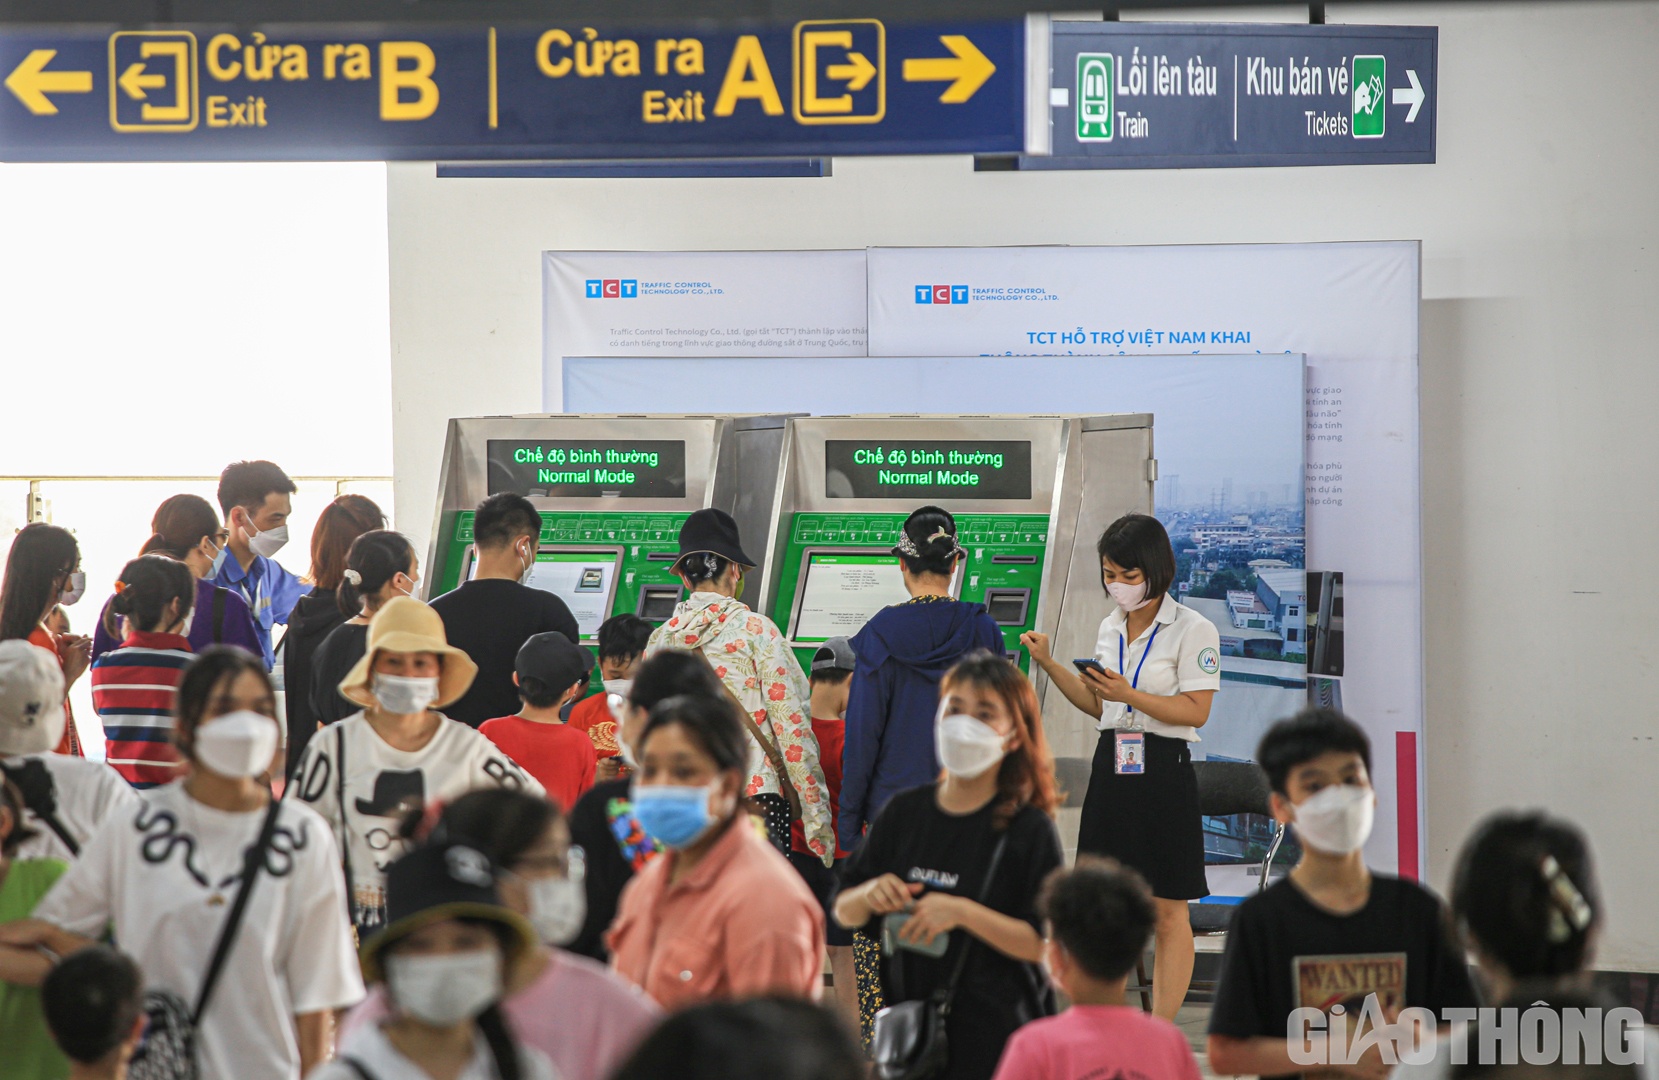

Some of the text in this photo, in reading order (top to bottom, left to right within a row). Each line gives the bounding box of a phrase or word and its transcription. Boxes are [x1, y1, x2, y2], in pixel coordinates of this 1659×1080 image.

[205, 32, 440, 121] Cửa ra B
[535, 27, 784, 117] Cửa ra A
[1116, 46, 1218, 97] Lối lên tàu
[1246, 55, 1349, 97] Khu bán vé
[206, 95, 267, 128] Exit
[642, 89, 705, 123] Exit
[1117, 111, 1149, 138] Train
[1304, 111, 1348, 137] Tickets
[586, 280, 637, 297] TCT
[916, 287, 968, 303] TCT
[610, 328, 633, 336] Traffic
[634, 328, 663, 336] Control
[665, 328, 709, 336] Technology
[710, 328, 725, 336] Co.,
[726, 328, 741, 336] Ltd.
[798, 327, 821, 335] thành
[836, 327, 851, 335] vào
[1026, 326, 1251, 348] TCT HỖ TRỢ VIỆT NAM KHAI
[642, 339, 660, 348] tiếng
[662, 339, 683, 348] trong
[716, 340, 732, 348] giao
[734, 339, 756, 348] thông
[804, 340, 826, 348] Trung
[1323, 387, 1342, 396] giao
[1318, 434, 1342, 442] mạng
[514, 446, 659, 468] Chế độ bình thường
[854, 446, 1004, 469] Chế độ bình thường
[1307, 462, 1324, 470] hóa
[538, 468, 636, 484] Normal Mode
[878, 470, 980, 486] Normal Mode
[1318, 474, 1342, 482] người
[1332, 486, 1342, 494] án
[1301, 961, 1402, 991] WANTED
